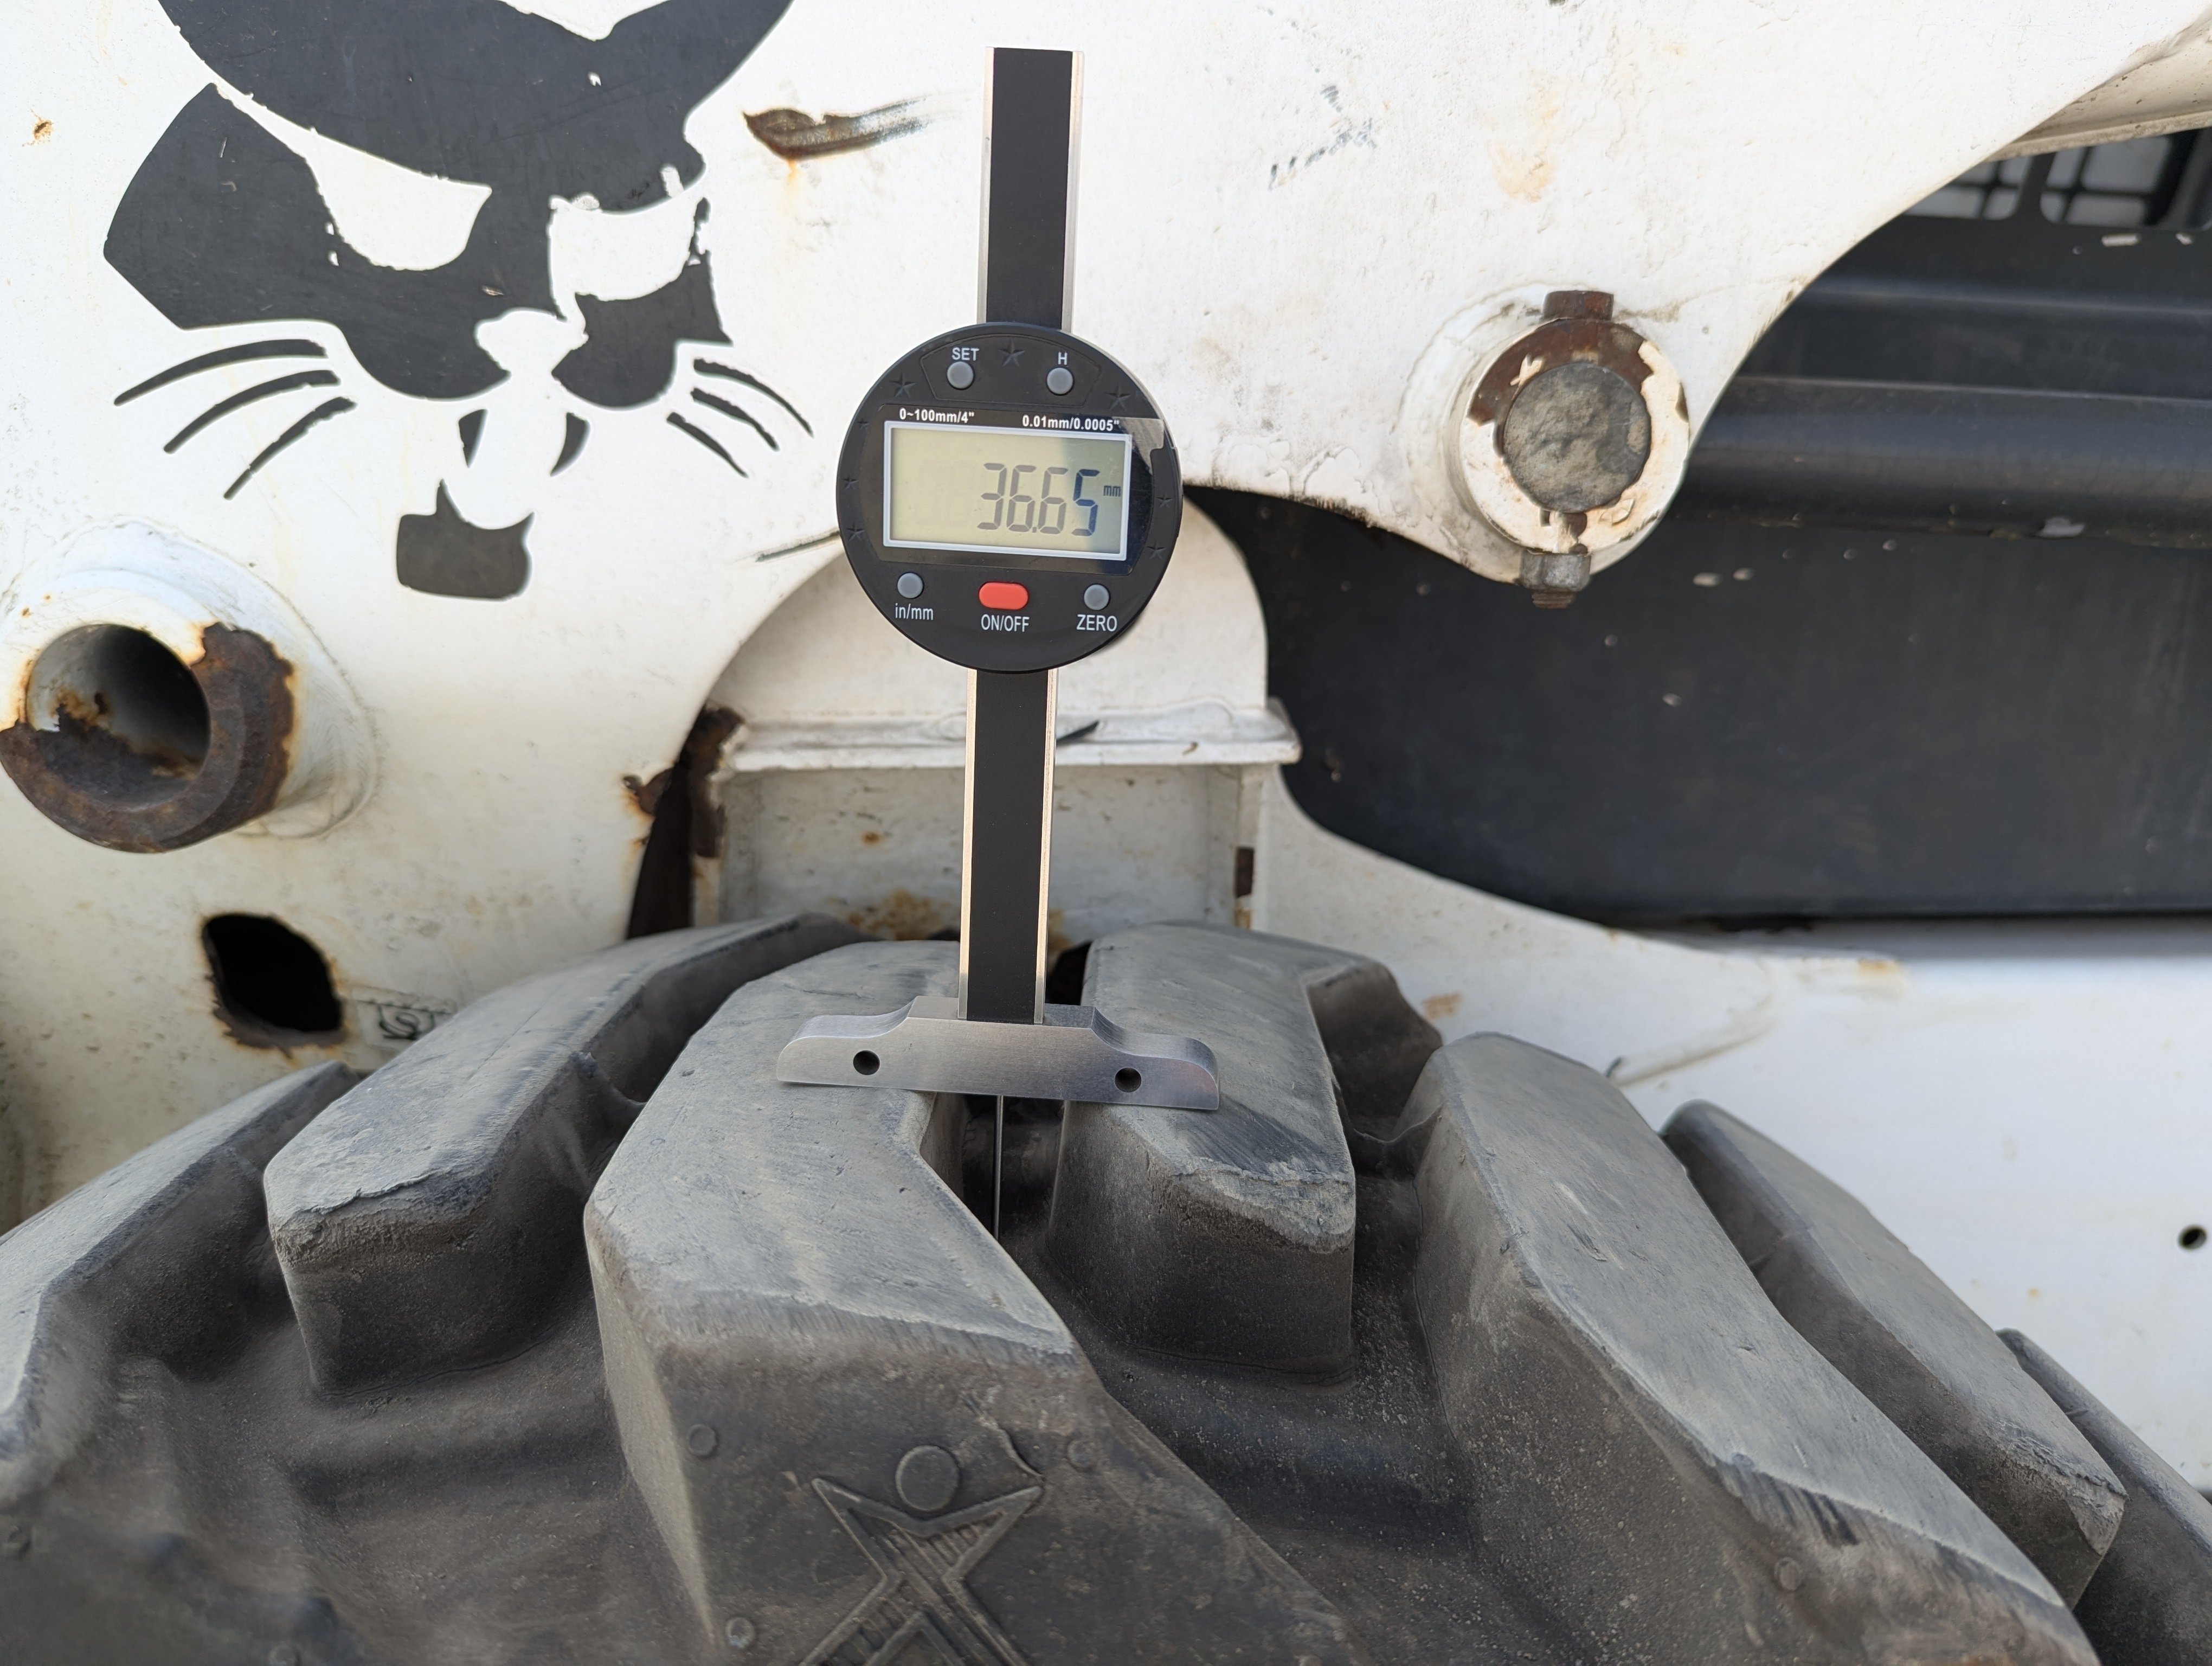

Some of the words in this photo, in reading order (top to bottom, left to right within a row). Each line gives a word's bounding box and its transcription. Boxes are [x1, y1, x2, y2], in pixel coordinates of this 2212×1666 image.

[951, 347, 979, 361] SET
[1057, 352, 1068, 366] H
[1022, 415, 1120, 432] 0.01mm/0.0005"
[976, 463, 1100, 537] 36.65
[1103, 484, 1121, 497] mm
[895, 604, 934, 621] in/mm
[980, 613, 1030, 632] ON/OFF
[1076, 614, 1118, 631] ZERO
